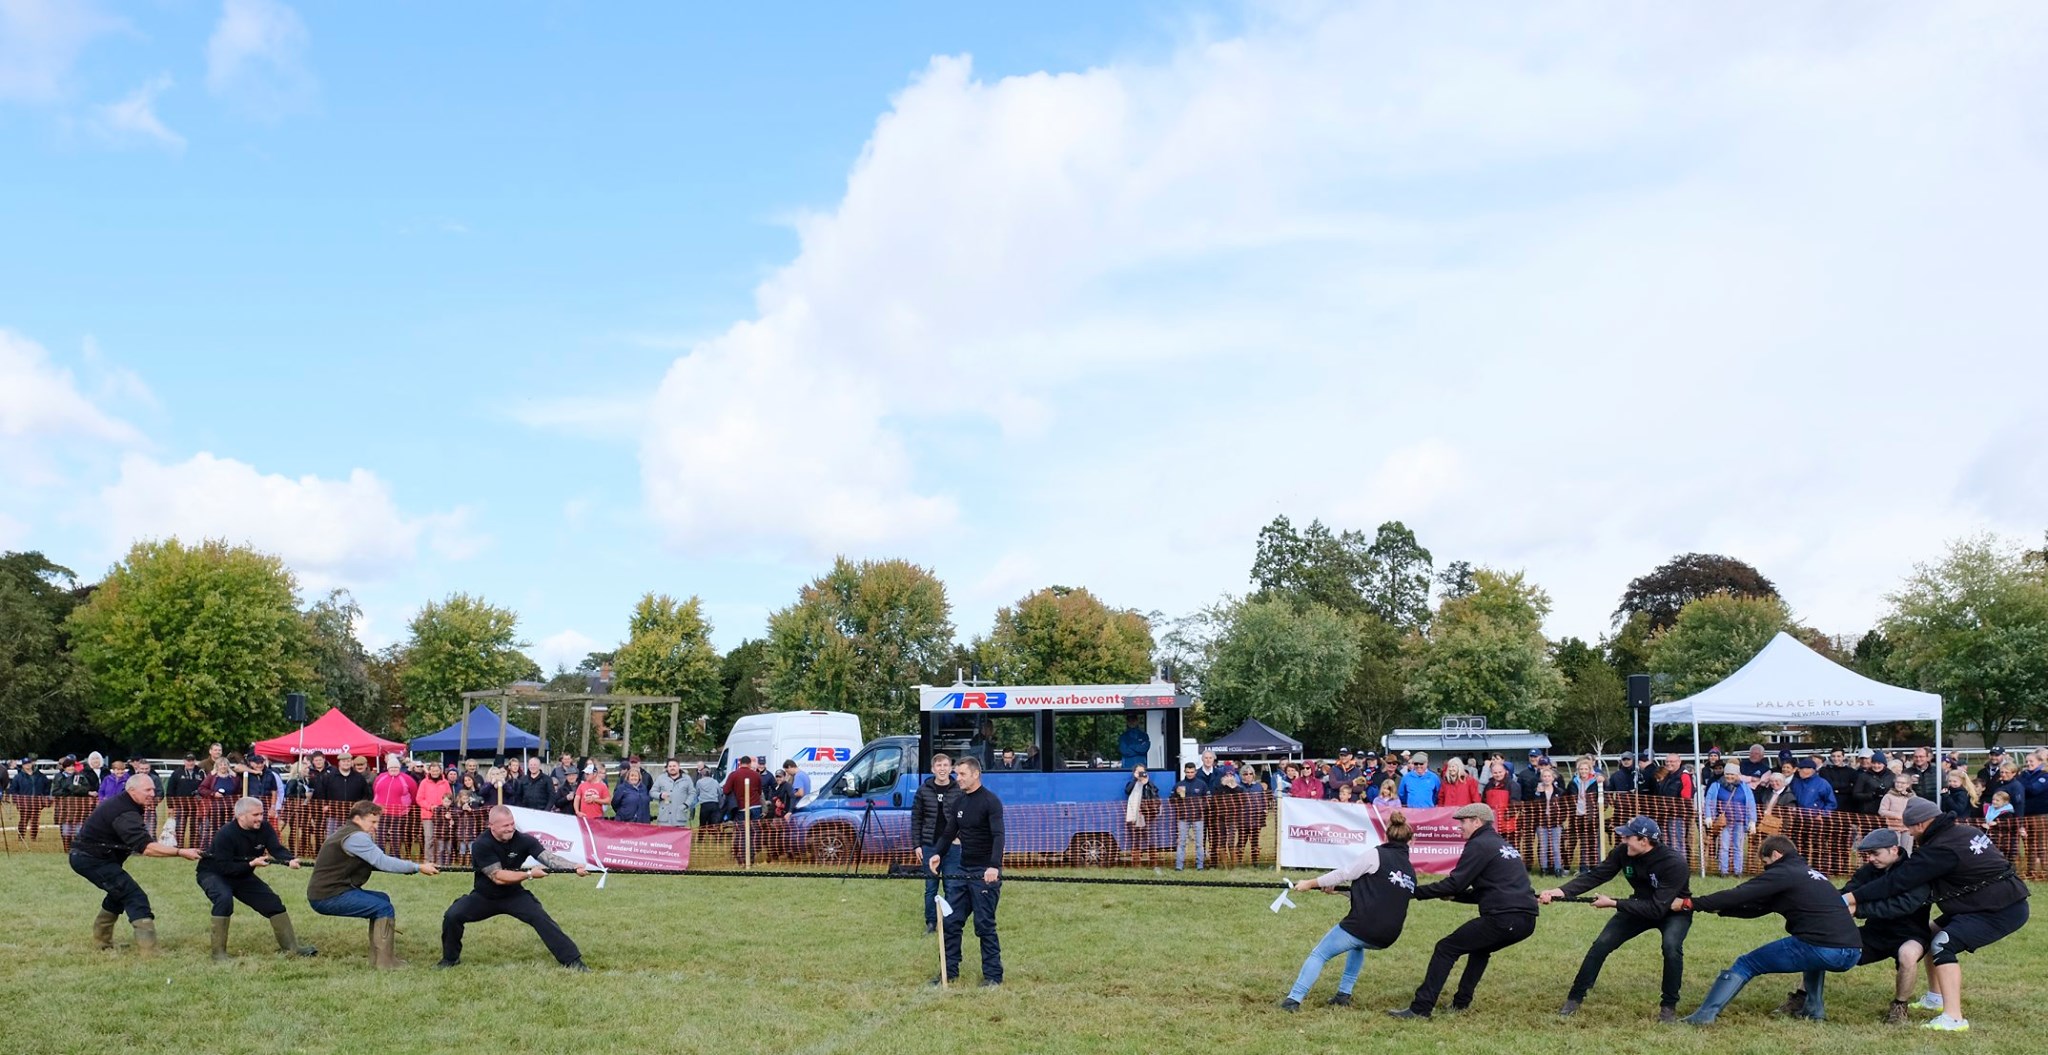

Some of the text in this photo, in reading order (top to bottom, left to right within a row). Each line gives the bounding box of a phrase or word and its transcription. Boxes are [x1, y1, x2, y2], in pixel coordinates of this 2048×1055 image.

[932, 692, 1008, 709] ARB
[1756, 699, 1875, 708] PALACE HOUSE
[1445, 718, 1484, 739] BAR
[792, 747, 851, 761] ARB
[1290, 827, 1364, 841] MARTIN COLLINS
[607, 844, 633, 852] standard
[650, 842, 673, 850] winning
